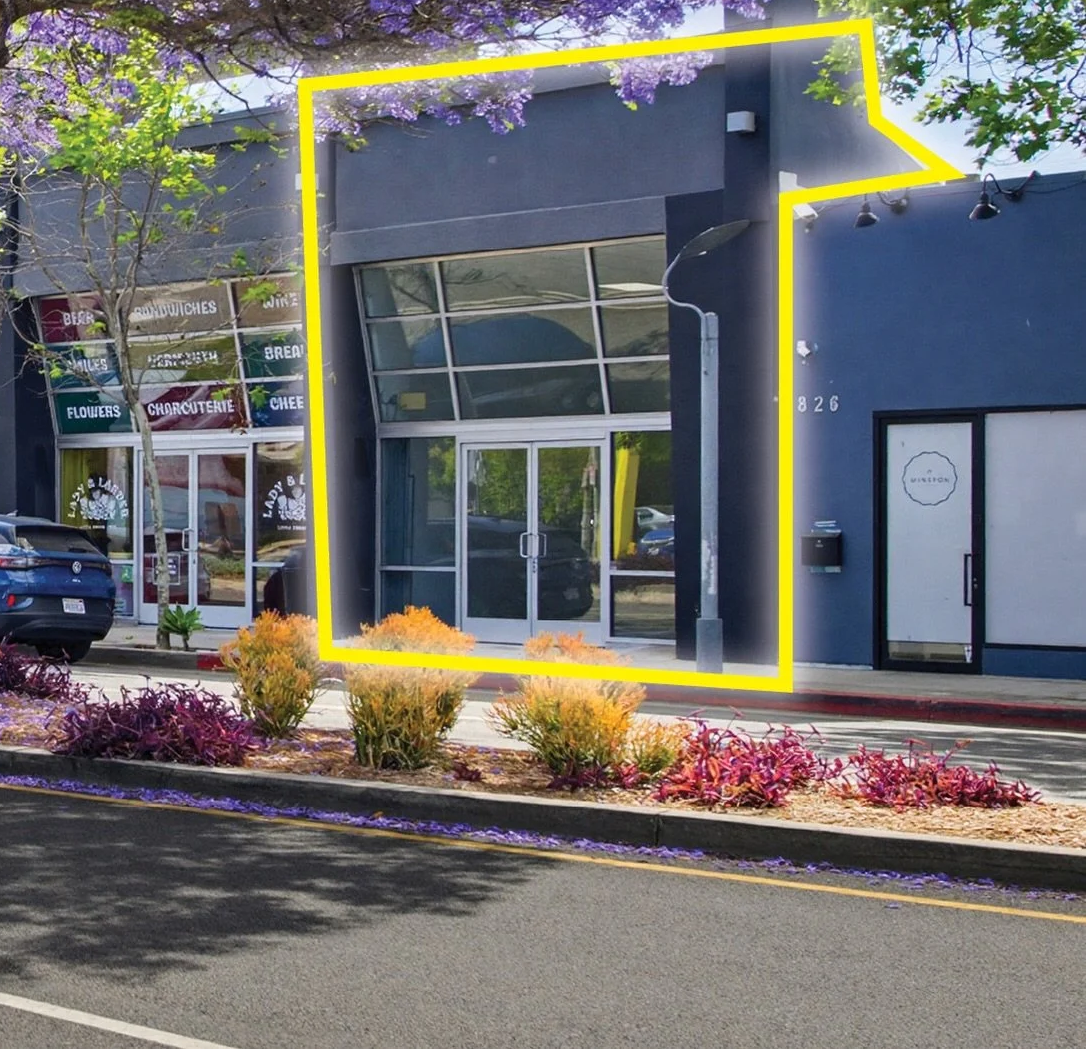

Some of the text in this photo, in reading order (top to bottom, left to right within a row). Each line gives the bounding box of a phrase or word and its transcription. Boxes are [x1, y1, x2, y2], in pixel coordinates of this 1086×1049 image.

[133, 300, 218, 319] SANDWICHES
[264, 344, 305, 361] BREA
[147, 399, 235, 416] CHARCUTERIE
[270, 395, 305, 411] CHEE
[798, 395, 839, 413] 826
[67, 404, 122, 420] FLOWERS
[263, 481, 283, 518] LADY
